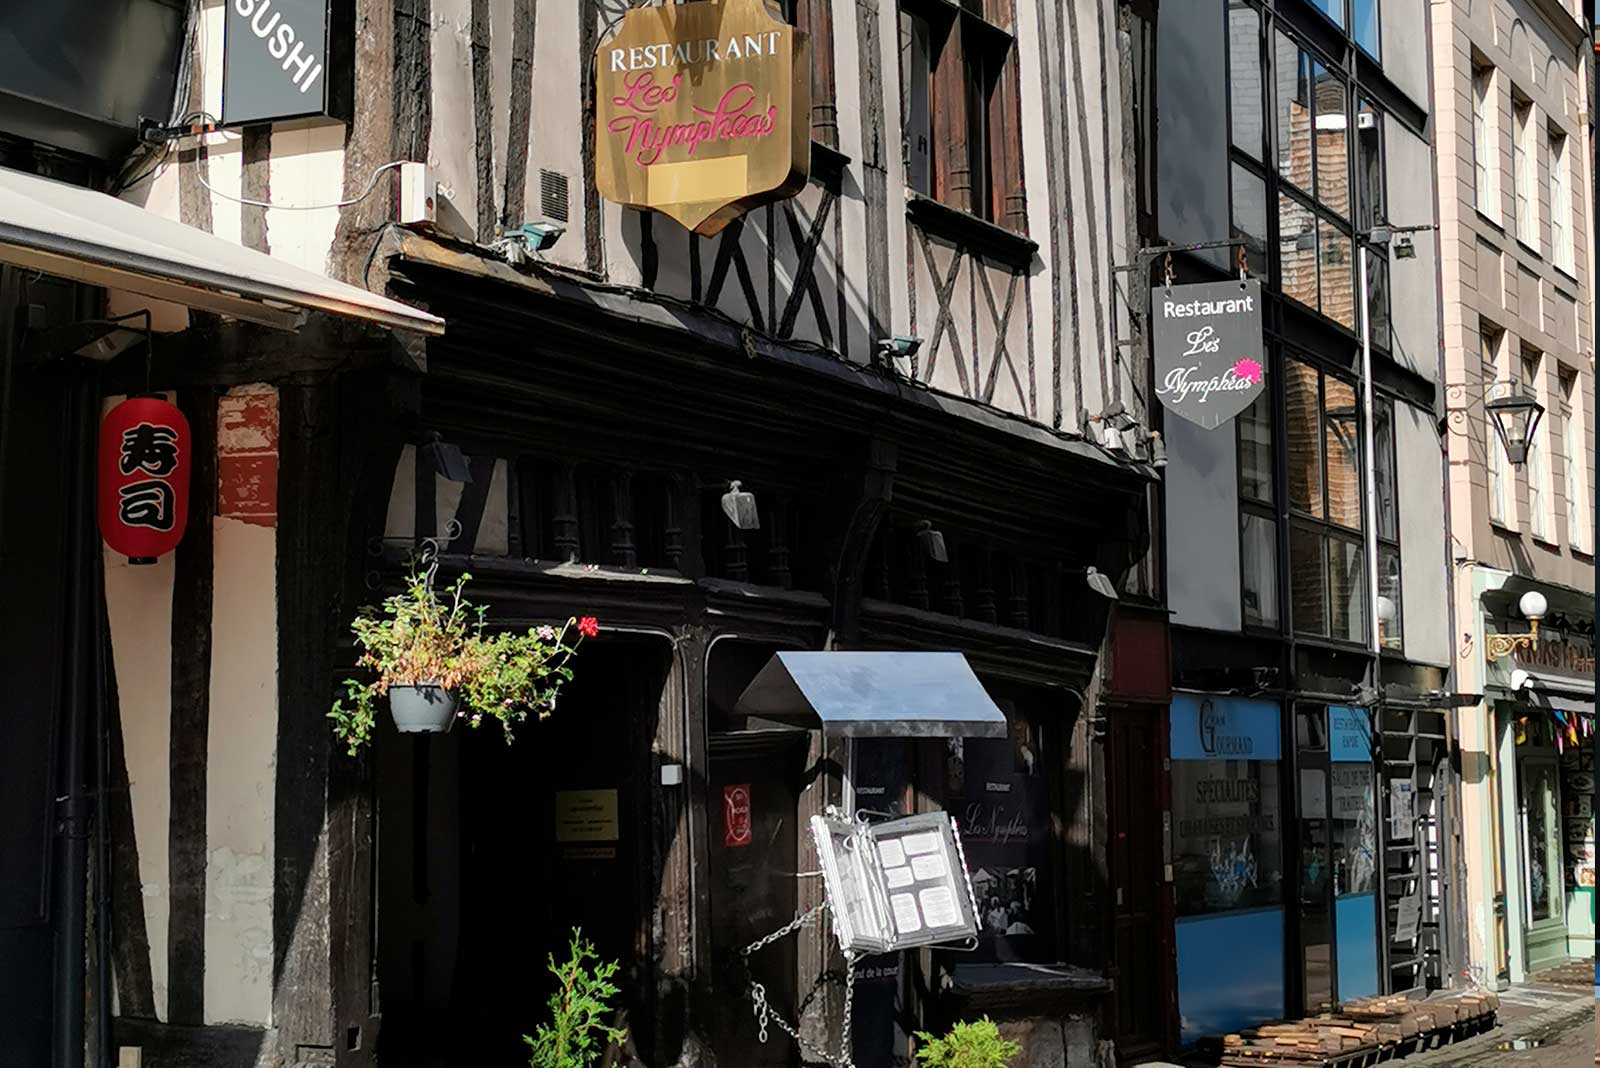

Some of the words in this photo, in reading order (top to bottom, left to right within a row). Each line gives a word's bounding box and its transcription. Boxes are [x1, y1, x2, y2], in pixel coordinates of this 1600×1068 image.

[609, 31, 781, 72] RESTAURANT
[612, 71, 682, 113] Les
[1163, 295, 1253, 318] Restaurant
[118, 421, 178, 532] 寿司
